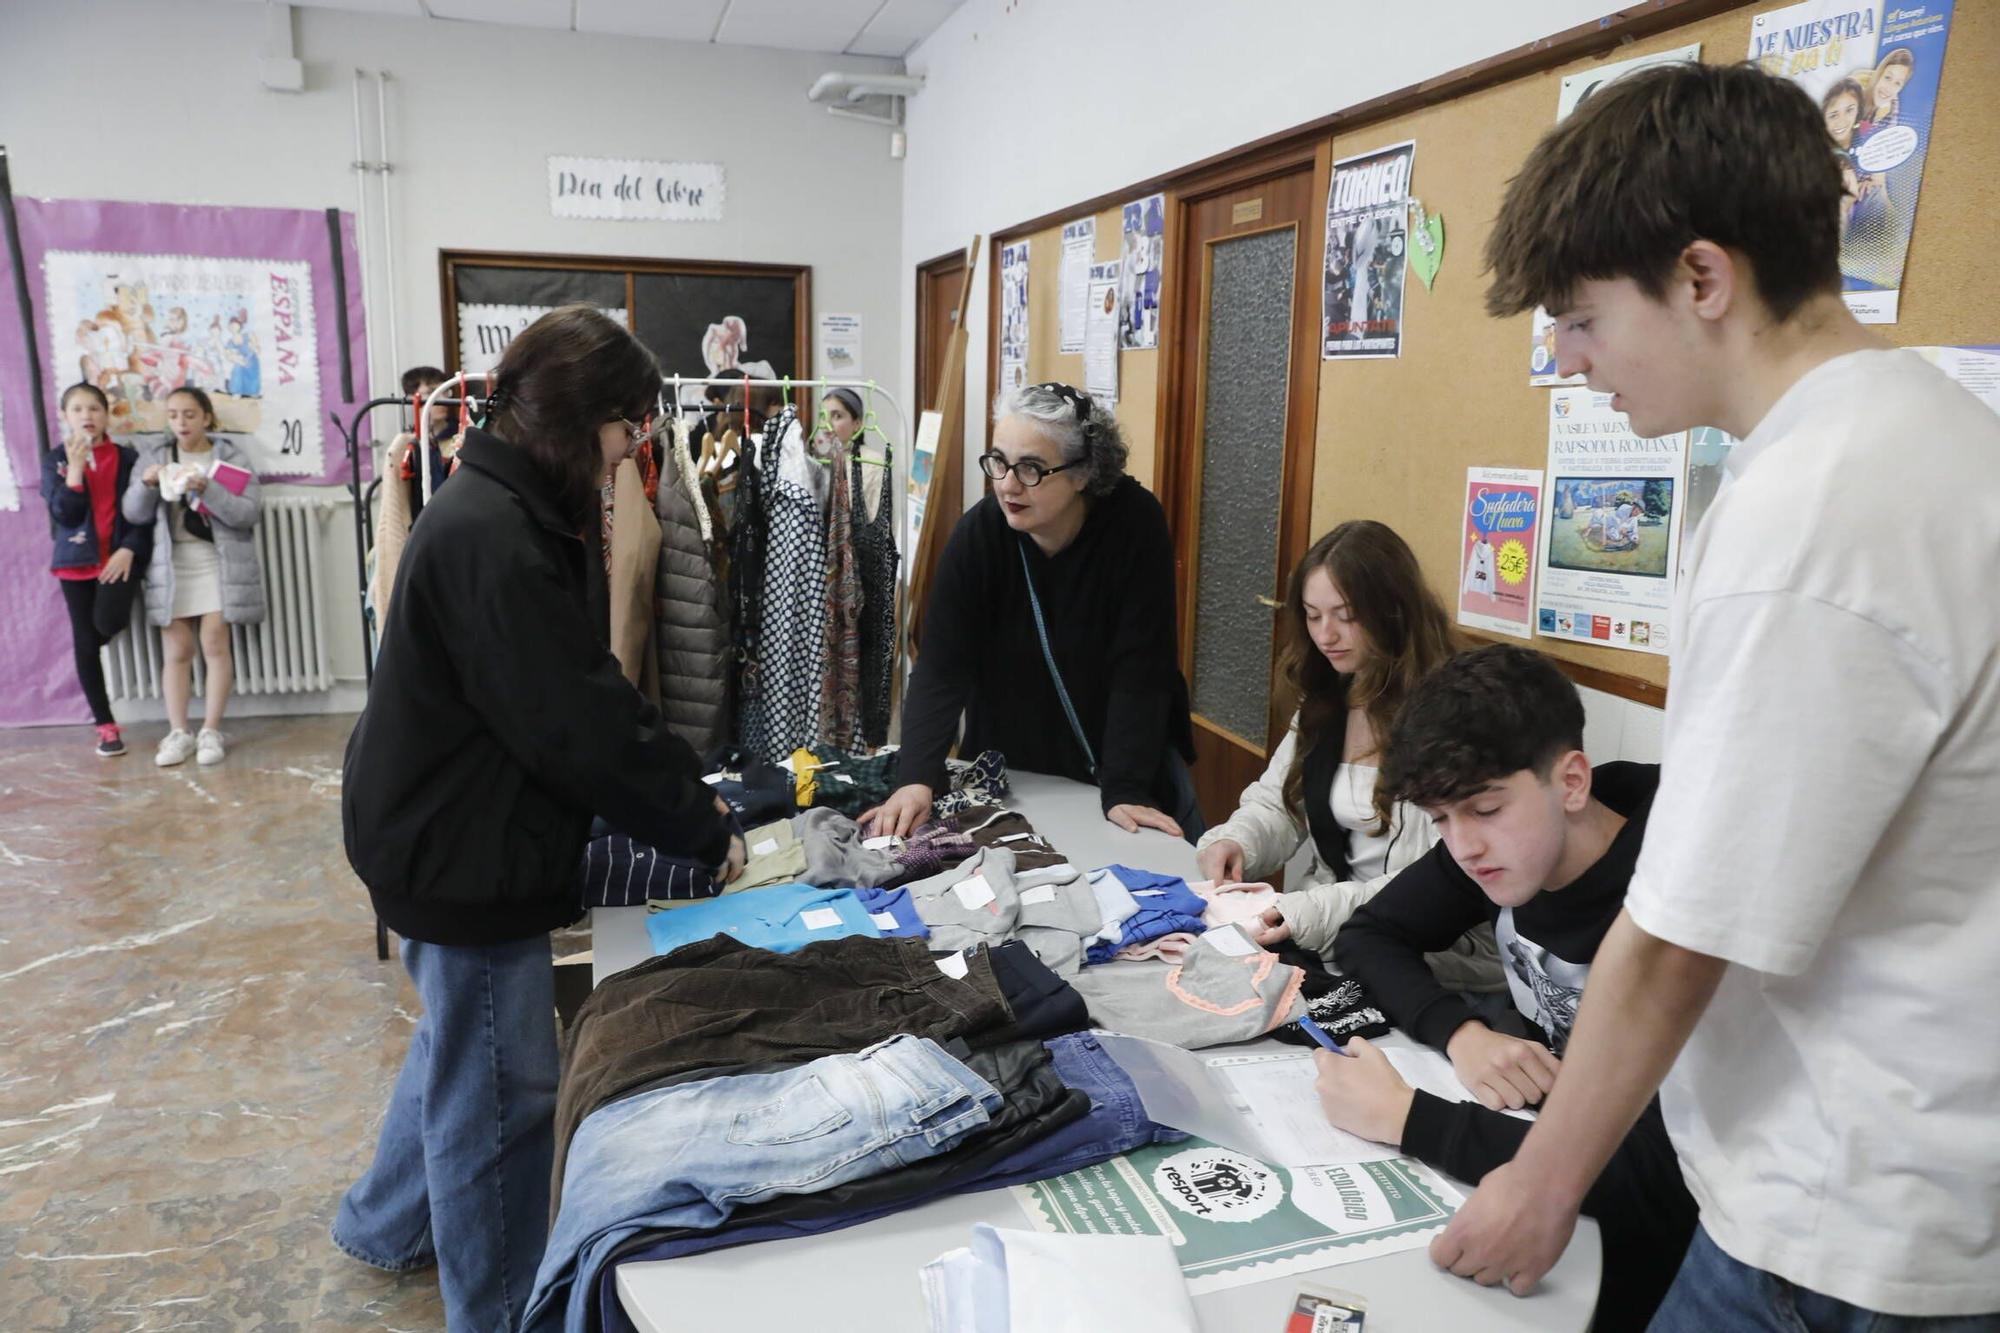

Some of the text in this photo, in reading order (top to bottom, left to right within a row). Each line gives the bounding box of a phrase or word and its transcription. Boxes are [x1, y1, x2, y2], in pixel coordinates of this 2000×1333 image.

[1783, 7, 1875, 54] NUESTRA
[614, 174, 643, 202] del
[1333, 154, 1408, 214] TORNEO
[270, 272, 299, 386] ESPAÑA
[280, 418, 302, 457] 20
[1469, 487, 1536, 517] Sudadera
[1482, 511, 1525, 532] Nueva
[1501, 553, 1525, 574] 25€
[1162, 1165, 1213, 1216] resport
